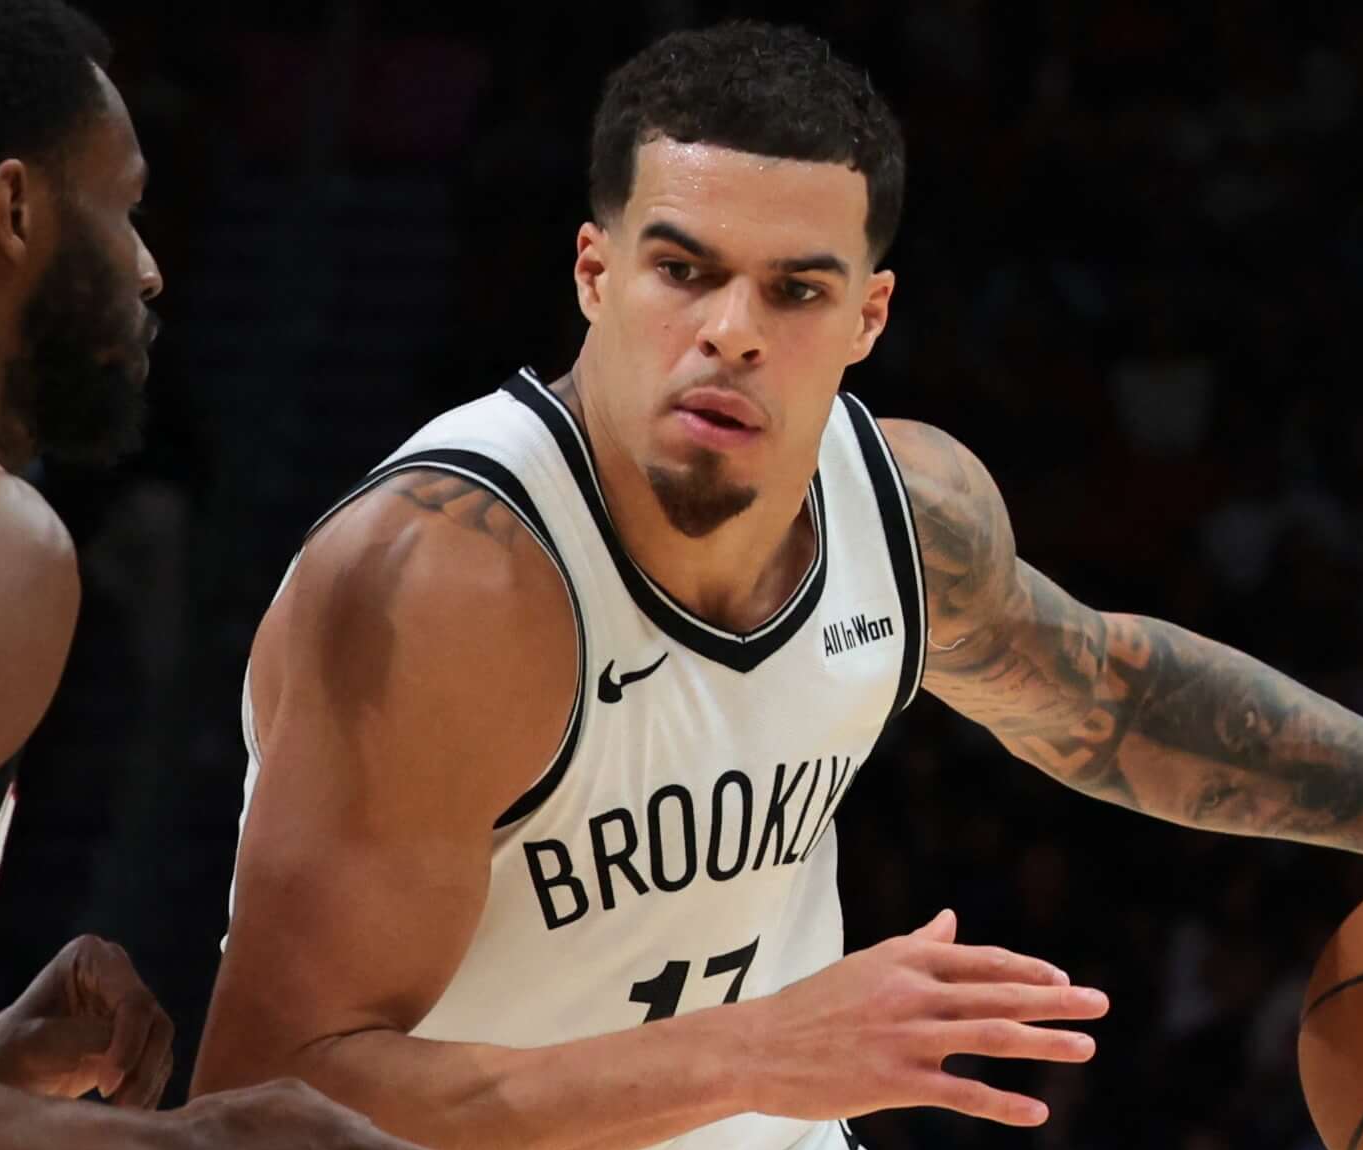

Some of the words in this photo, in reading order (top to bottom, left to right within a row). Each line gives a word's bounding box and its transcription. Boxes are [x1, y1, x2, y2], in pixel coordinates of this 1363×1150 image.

[823, 623, 843, 657] All
[840, 620, 857, 650] In
[851, 613, 894, 646] Won
